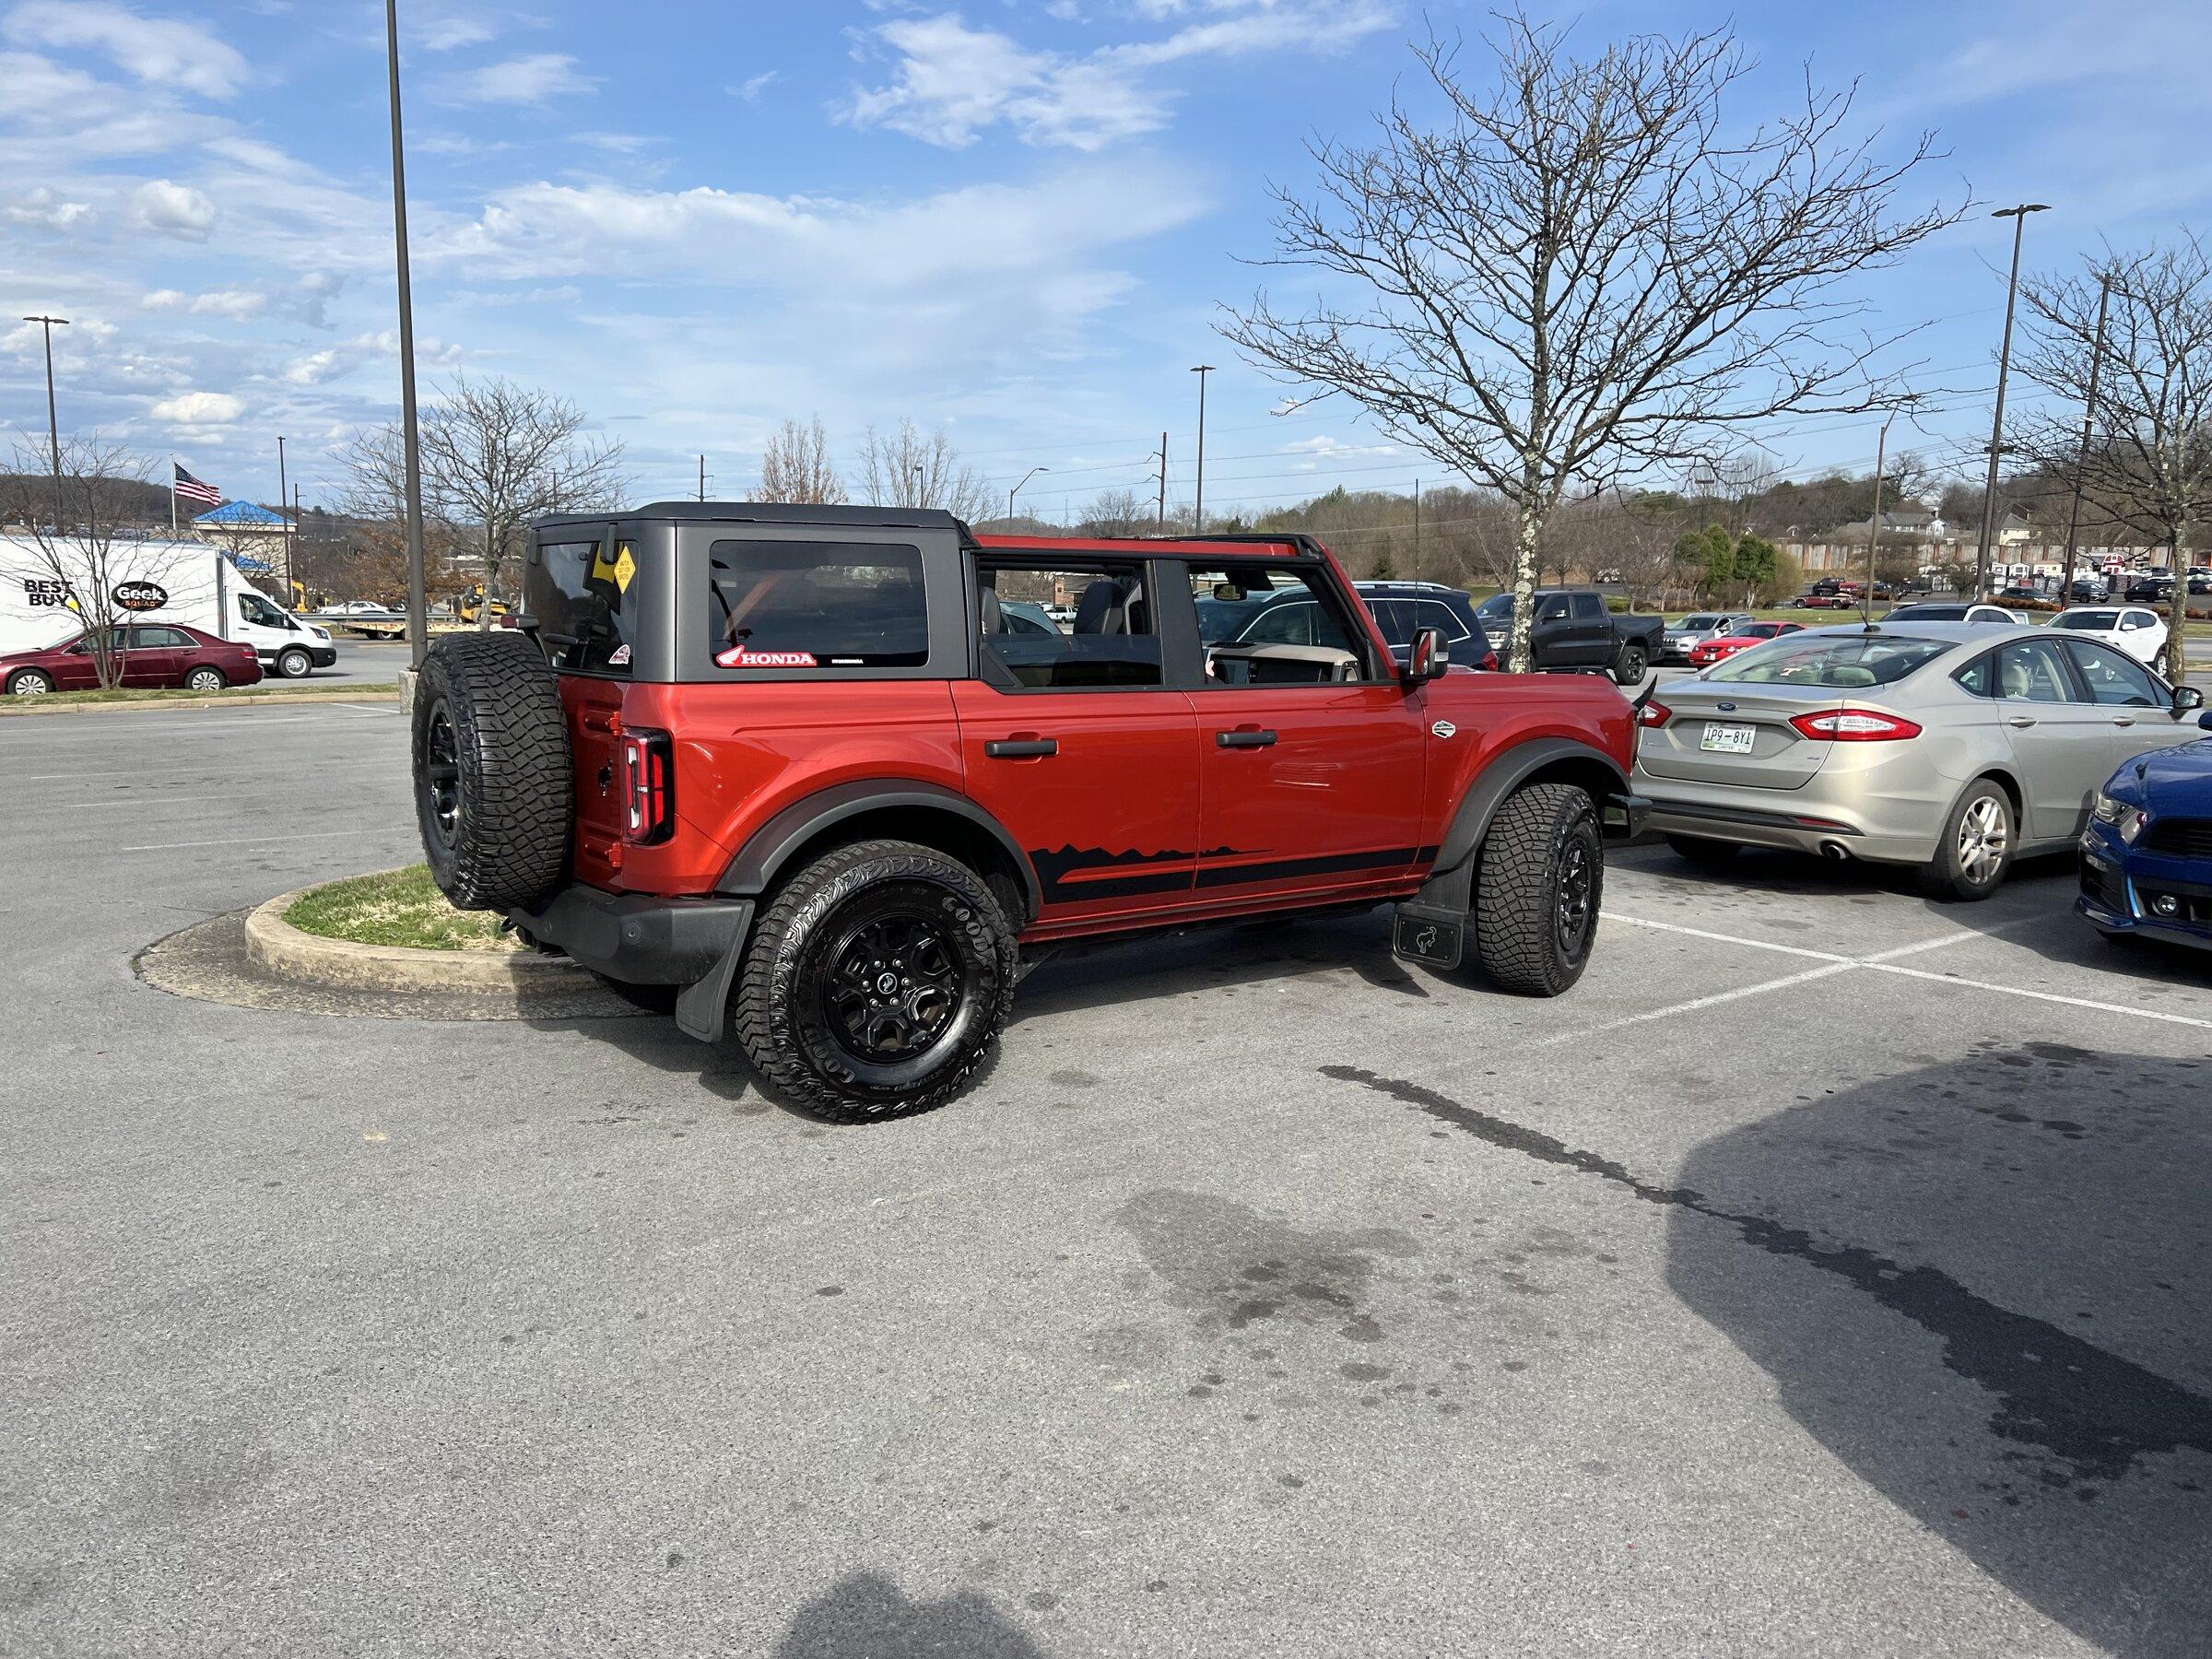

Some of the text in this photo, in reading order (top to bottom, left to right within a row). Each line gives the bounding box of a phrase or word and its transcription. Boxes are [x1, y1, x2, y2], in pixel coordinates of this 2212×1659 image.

[24, 579, 73, 594] BEST
[116, 586, 164, 601] Geek
[29, 594, 70, 607] BUY
[741, 653, 816, 665] HONDA
[1704, 728, 1751, 745] 1P9-8Y1
